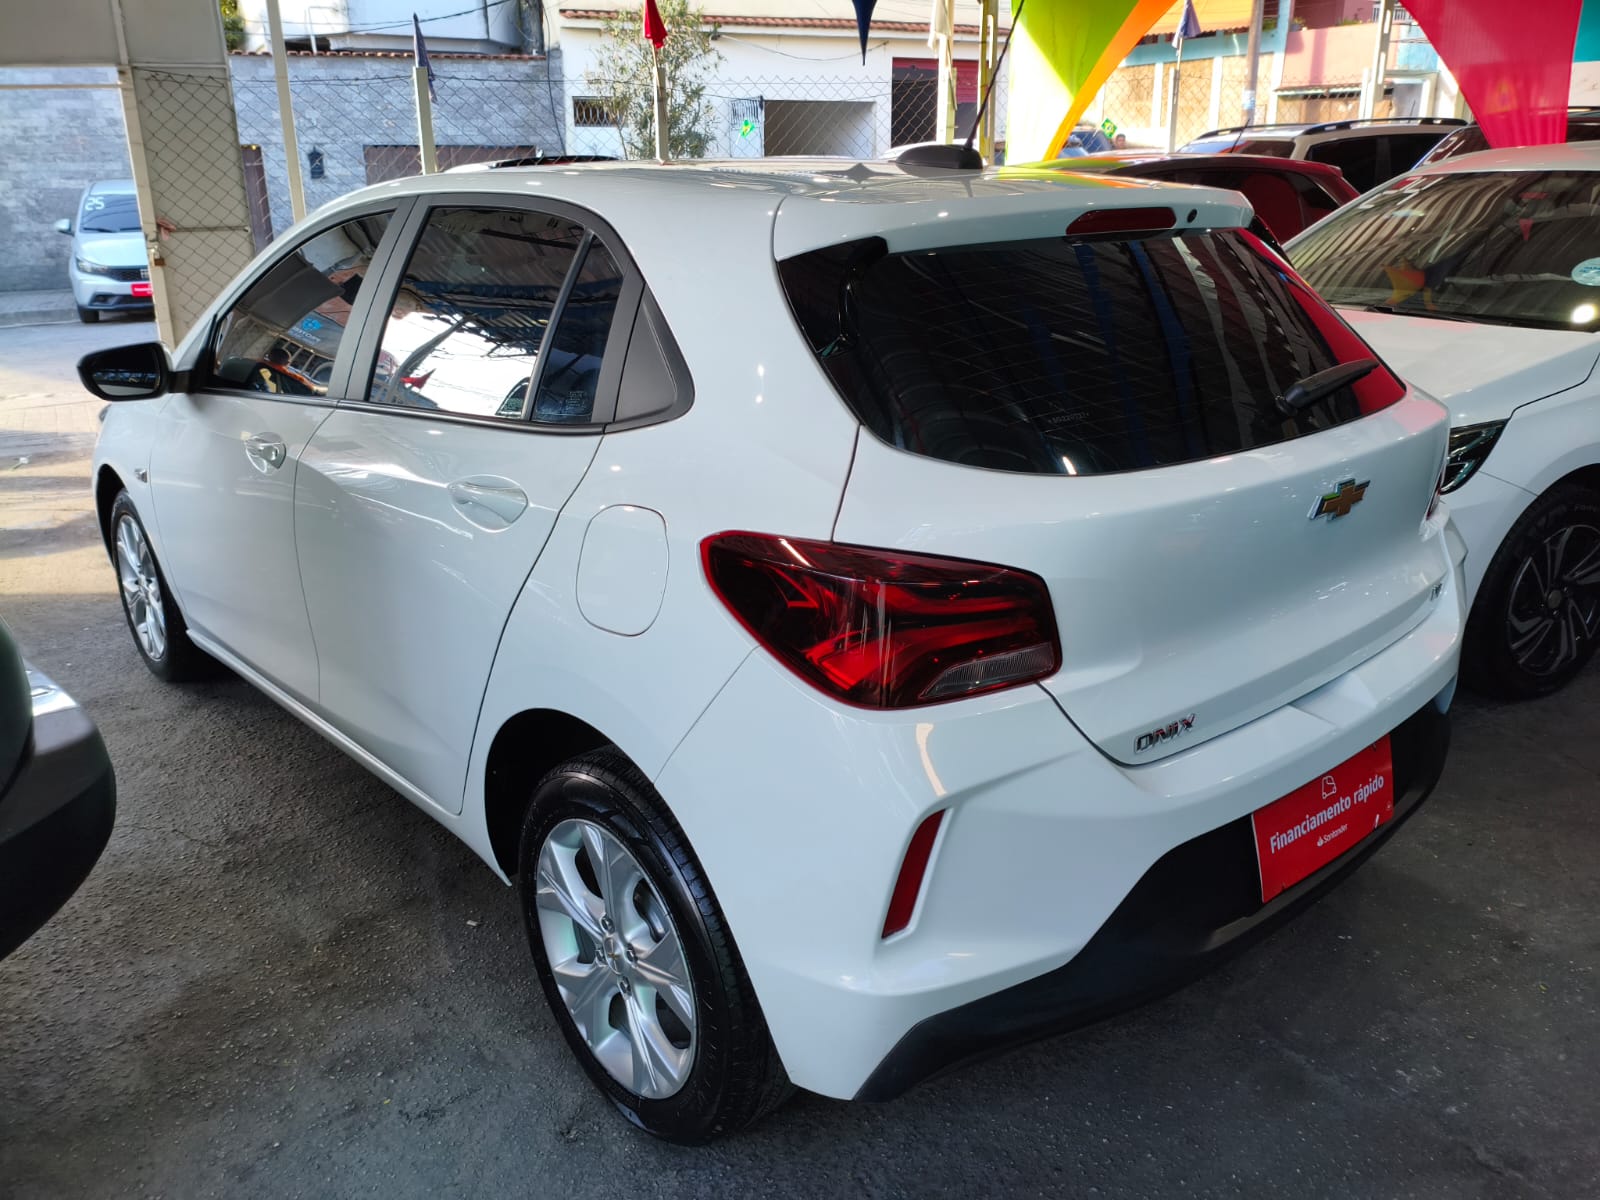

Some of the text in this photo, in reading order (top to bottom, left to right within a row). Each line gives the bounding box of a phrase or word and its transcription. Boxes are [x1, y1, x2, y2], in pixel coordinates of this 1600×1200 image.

[84, 196, 105, 211] 25
[1134, 713, 1196, 754] ONIX
[1269, 775, 1384, 854] Financiamento rápido
[1323, 823, 1348, 844] Santander
